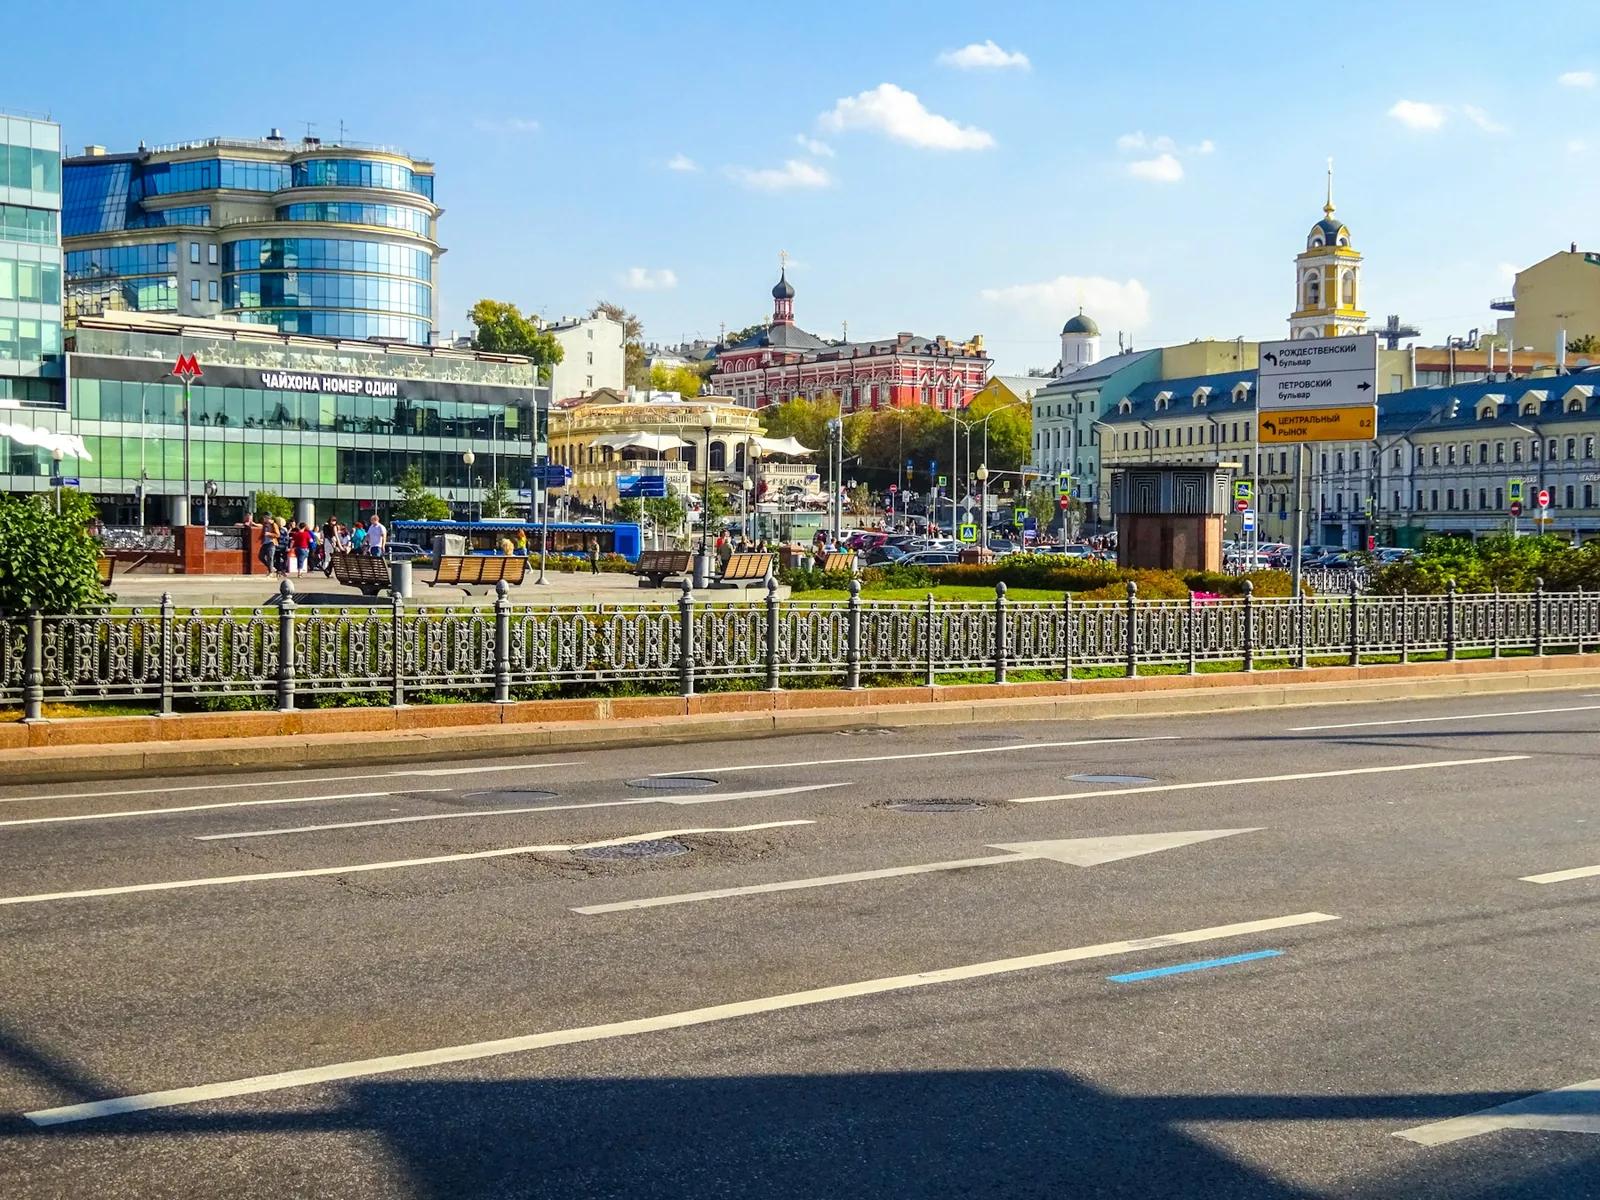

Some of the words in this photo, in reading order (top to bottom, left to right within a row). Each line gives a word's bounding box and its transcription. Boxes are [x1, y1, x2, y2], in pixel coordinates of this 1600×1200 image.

[1279, 344, 1357, 357] РОЖДЕСТВЕНСКИЙ
[1279, 359, 1311, 368] бульвар
[262, 372, 320, 391] ЧАЙХОНА
[323, 378, 363, 394] НОМЕР
[365, 381, 398, 396] ОДИН
[1278, 378, 1332, 390] ПЕТРОВСКИЙ
[1278, 391, 1311, 400] бульвар
[1278, 414, 1340, 425] ЦЕНТРАЛЬНЫЙ
[1278, 428, 1307, 436] РЫНОК
